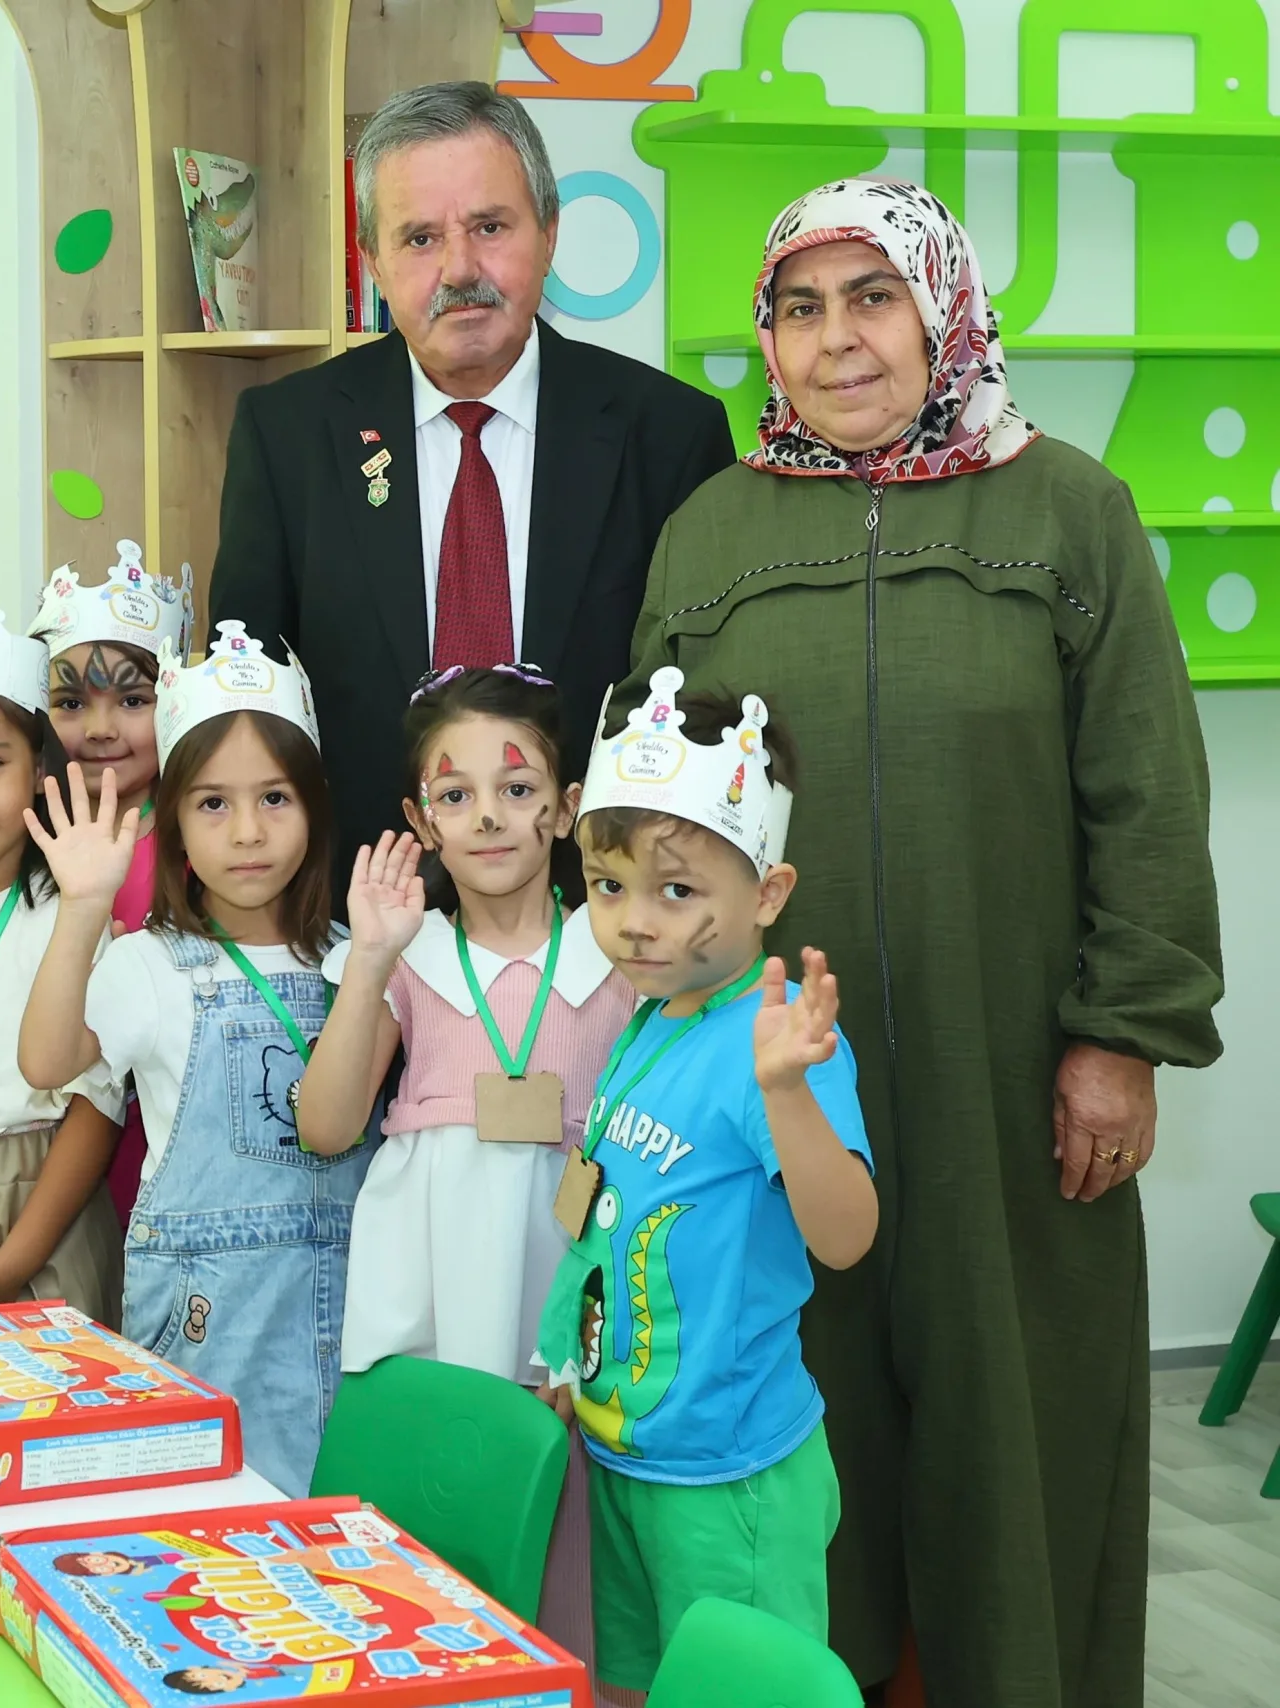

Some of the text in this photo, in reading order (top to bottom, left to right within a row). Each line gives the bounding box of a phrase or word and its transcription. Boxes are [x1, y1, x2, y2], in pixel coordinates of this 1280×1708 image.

[651, 704, 670, 723] B
[604, 1102, 694, 1176] HAPPY
[170, 1554, 363, 1662] BİLGİLİ
[190, 1613, 284, 1662] ÇOOK
[260, 1561, 390, 1642] ÇOCUKLAR
